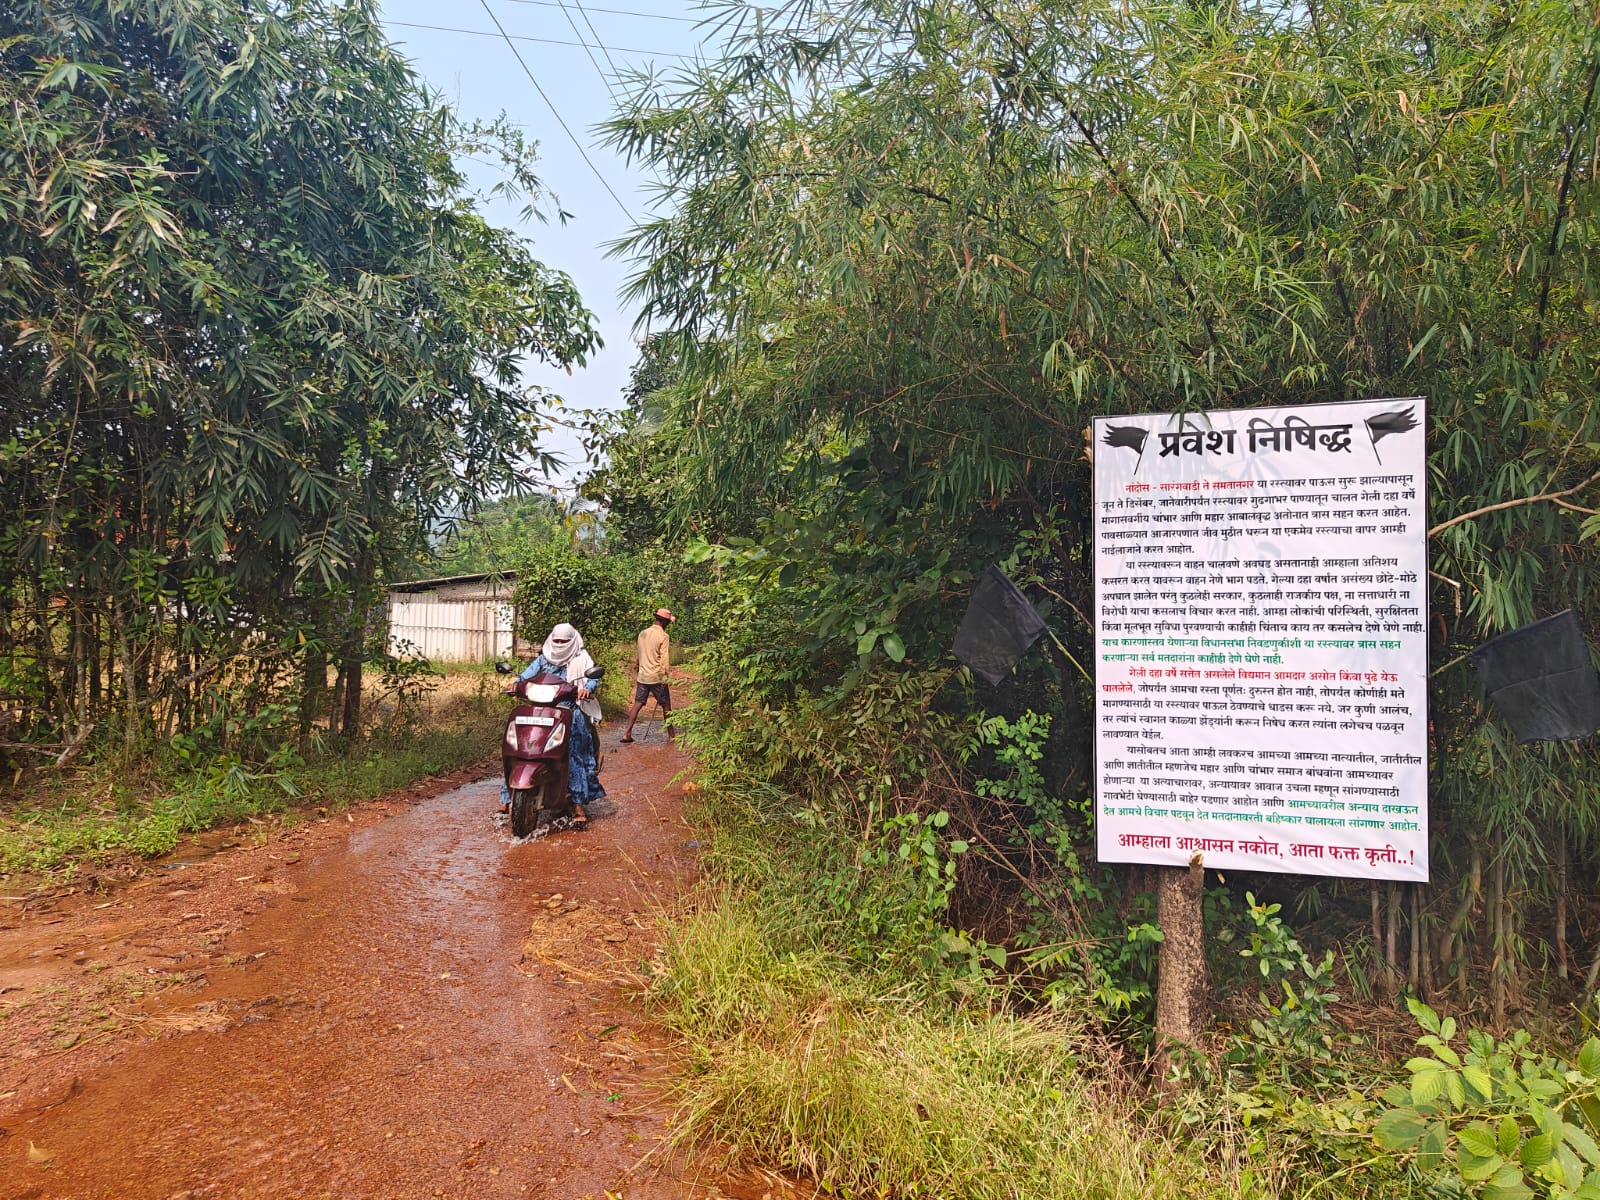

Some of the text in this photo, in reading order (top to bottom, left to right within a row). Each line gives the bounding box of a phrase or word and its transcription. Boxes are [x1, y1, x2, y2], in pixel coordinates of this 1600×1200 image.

[1158, 415, 1353, 458] प्रवेश निषिद्ध
[1379, 521, 1406, 534] आम्ही
[1322, 558, 1359, 568] आम्हाला
[1192, 746, 1216, 758] आम्ही
[1118, 833, 1171, 849] आम्हाला
[1175, 836, 1234, 853] आश्वासन
[1237, 835, 1283, 859] नकोत,
